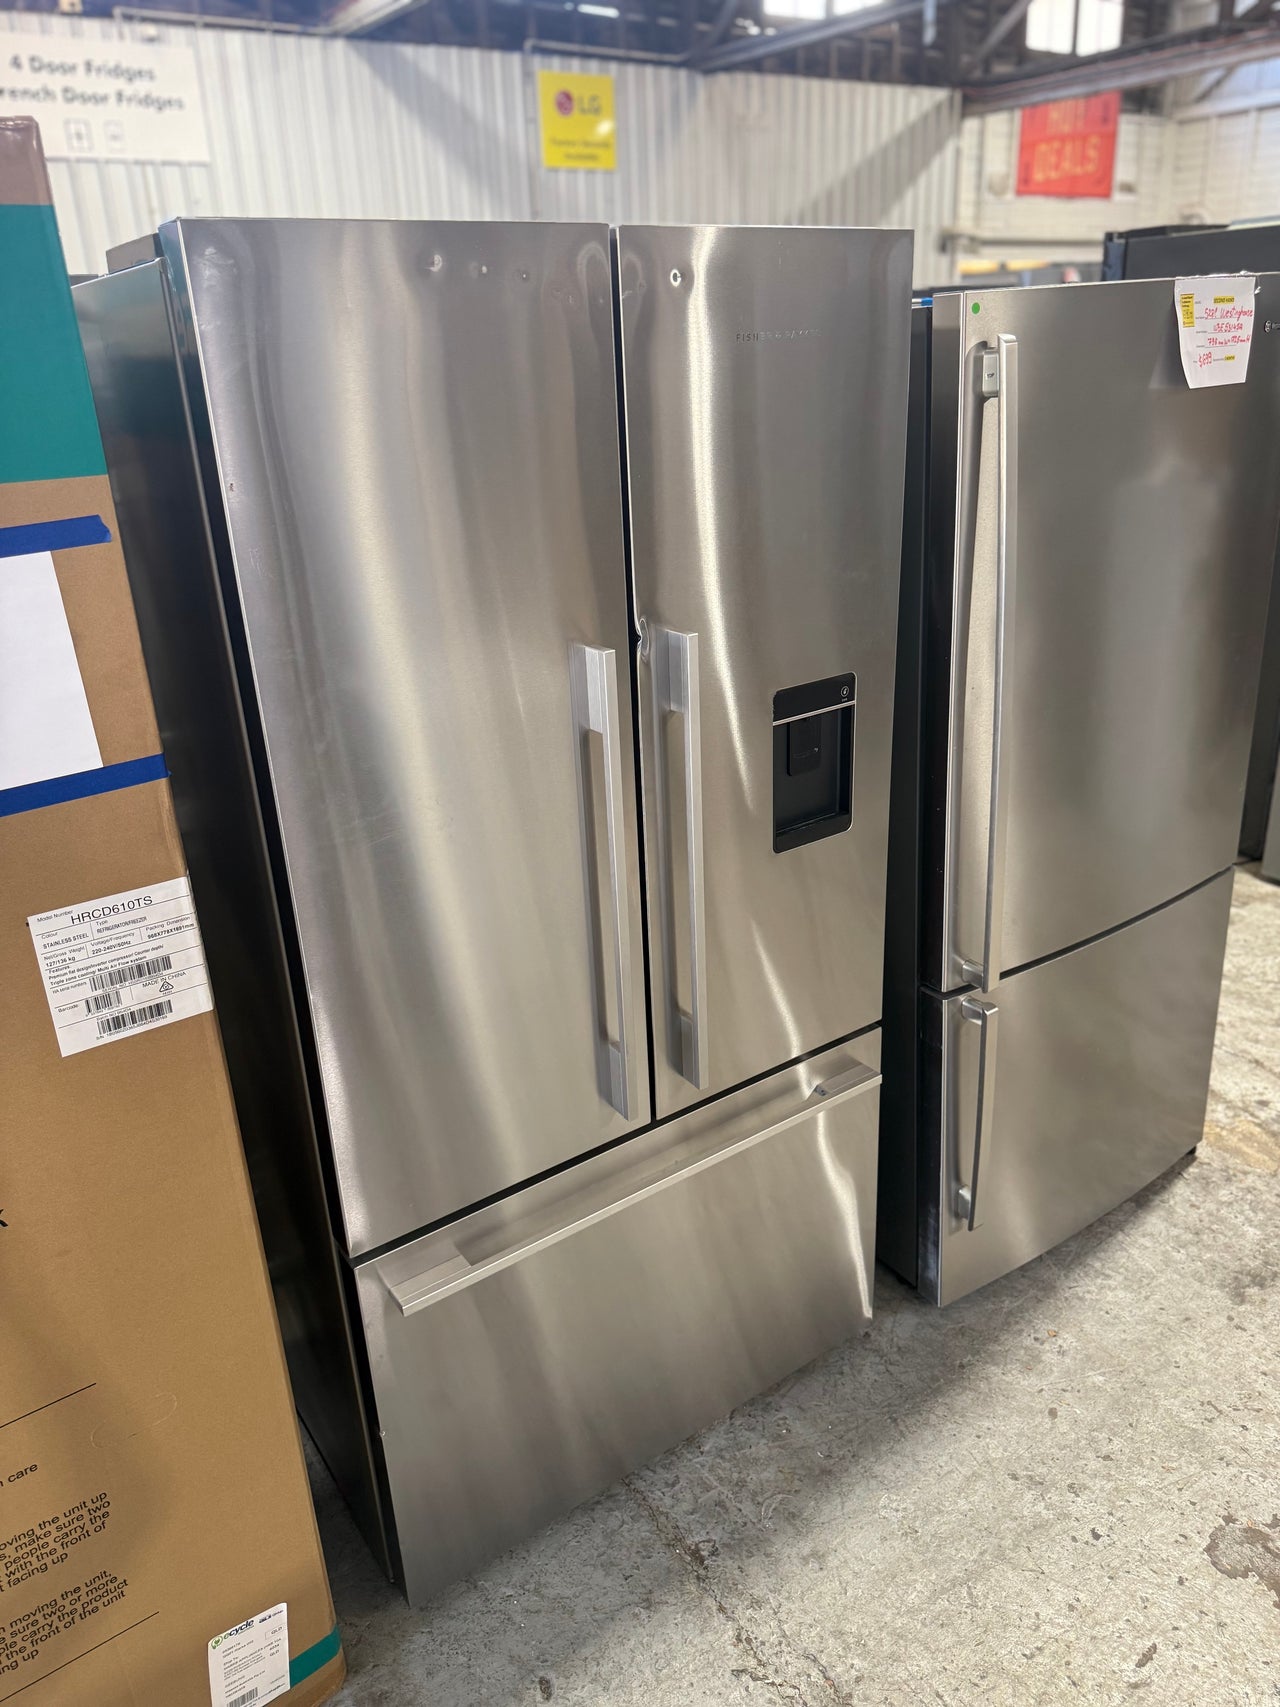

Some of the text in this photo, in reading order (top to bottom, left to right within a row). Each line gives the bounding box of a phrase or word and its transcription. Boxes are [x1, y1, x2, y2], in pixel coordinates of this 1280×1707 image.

[10, 54, 156, 83] 4 Door Fridges
[62, 86, 109, 106] Door
[116, 90, 185, 113] Fridges
[577, 94, 602, 116] LG
[1034, 134, 1100, 183] DEALS
[36, 909, 73, 922] Model Number
[70, 894, 153, 924] HRCD610TS
[145, 915, 190, 932] Packing Dimension
[40, 931, 58, 939] Colour
[42, 932, 89, 949] STAINLESS STEEL
[90, 931, 135, 948] Voltage/Frequency
[43, 945, 84, 960] Net/Gross Weight
[45, 957, 67, 967] 127/136
[48, 964, 69, 974] Features
[48, 971, 68, 980] Premium
[141, 979, 158, 987] MADE
[167, 970, 186, 980] CHINA
[50, 978, 65, 986] Triple
[8, 1464, 38, 1482] care
[38, 1516, 60, 1531] the
[63, 1500, 88, 1518] unit
[91, 1492, 107, 1505] up
[15, 1501, 111, 1553] make sure two
[4, 1541, 50, 1571] people
[53, 1522, 86, 1543] carry
[89, 1510, 110, 1525] the
[5, 1520, 107, 1578] with the front of
[7, 1552, 68, 1588] facing up
[9, 1570, 112, 1629] moving the unit,
[9, 1619, 39, 1638] sure
[42, 1605, 65, 1620] two
[69, 1595, 82, 1606] or
[86, 1576, 118, 1597] more
[21, 1620, 54, 1642] carry
[57, 1608, 78, 1622] the
[81, 1579, 128, 1610] product
[5, 1590, 126, 1660] the front of the unit
[223, 1619, 255, 1640] ecycle
[22, 1649, 39, 1662] up
